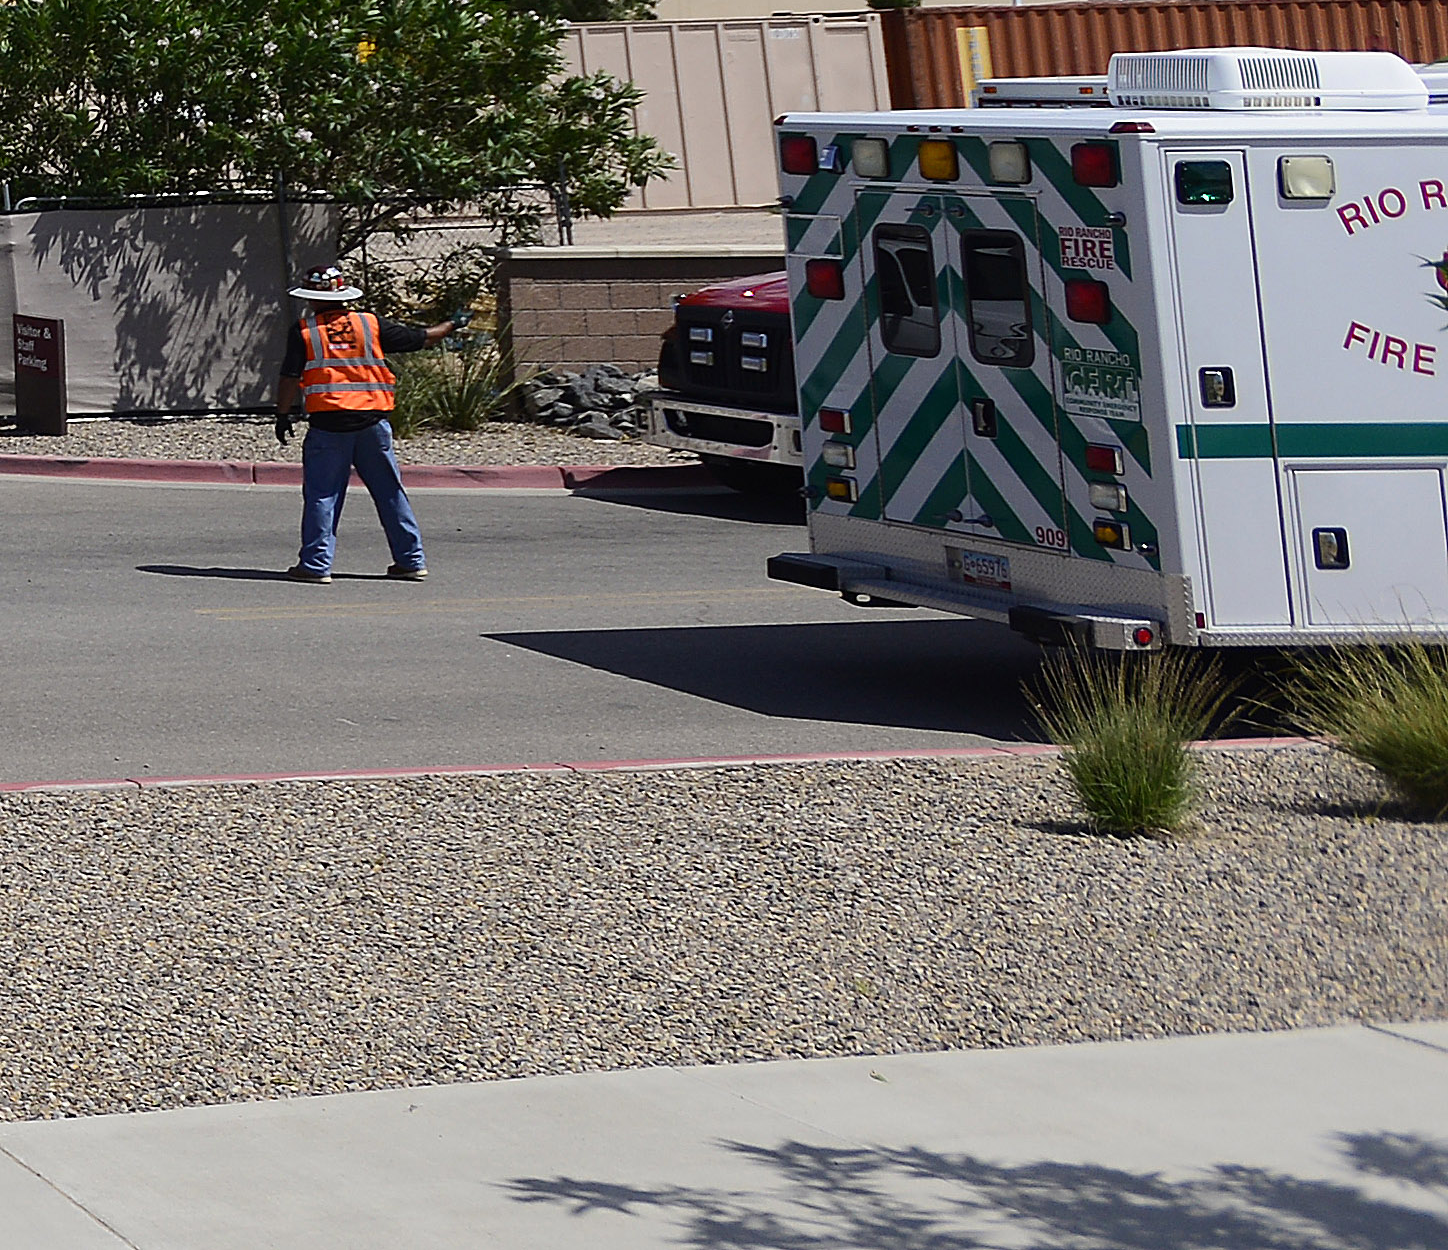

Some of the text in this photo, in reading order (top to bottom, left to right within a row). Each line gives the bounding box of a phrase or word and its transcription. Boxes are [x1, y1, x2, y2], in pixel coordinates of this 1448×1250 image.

[1336, 180, 1448, 235] RIO R
[1059, 226, 1111, 239] RIO RANCHO
[1060, 237, 1113, 260] FIRE
[1061, 256, 1114, 270] RESCUE
[16, 323, 52, 339] Visitor &
[17, 338, 35, 351] Staff
[1343, 321, 1437, 376] FIRE
[18, 353, 48, 372] Parking
[1064, 347, 1130, 366] RIO RANCHO
[1036, 526, 1065, 547] 909
